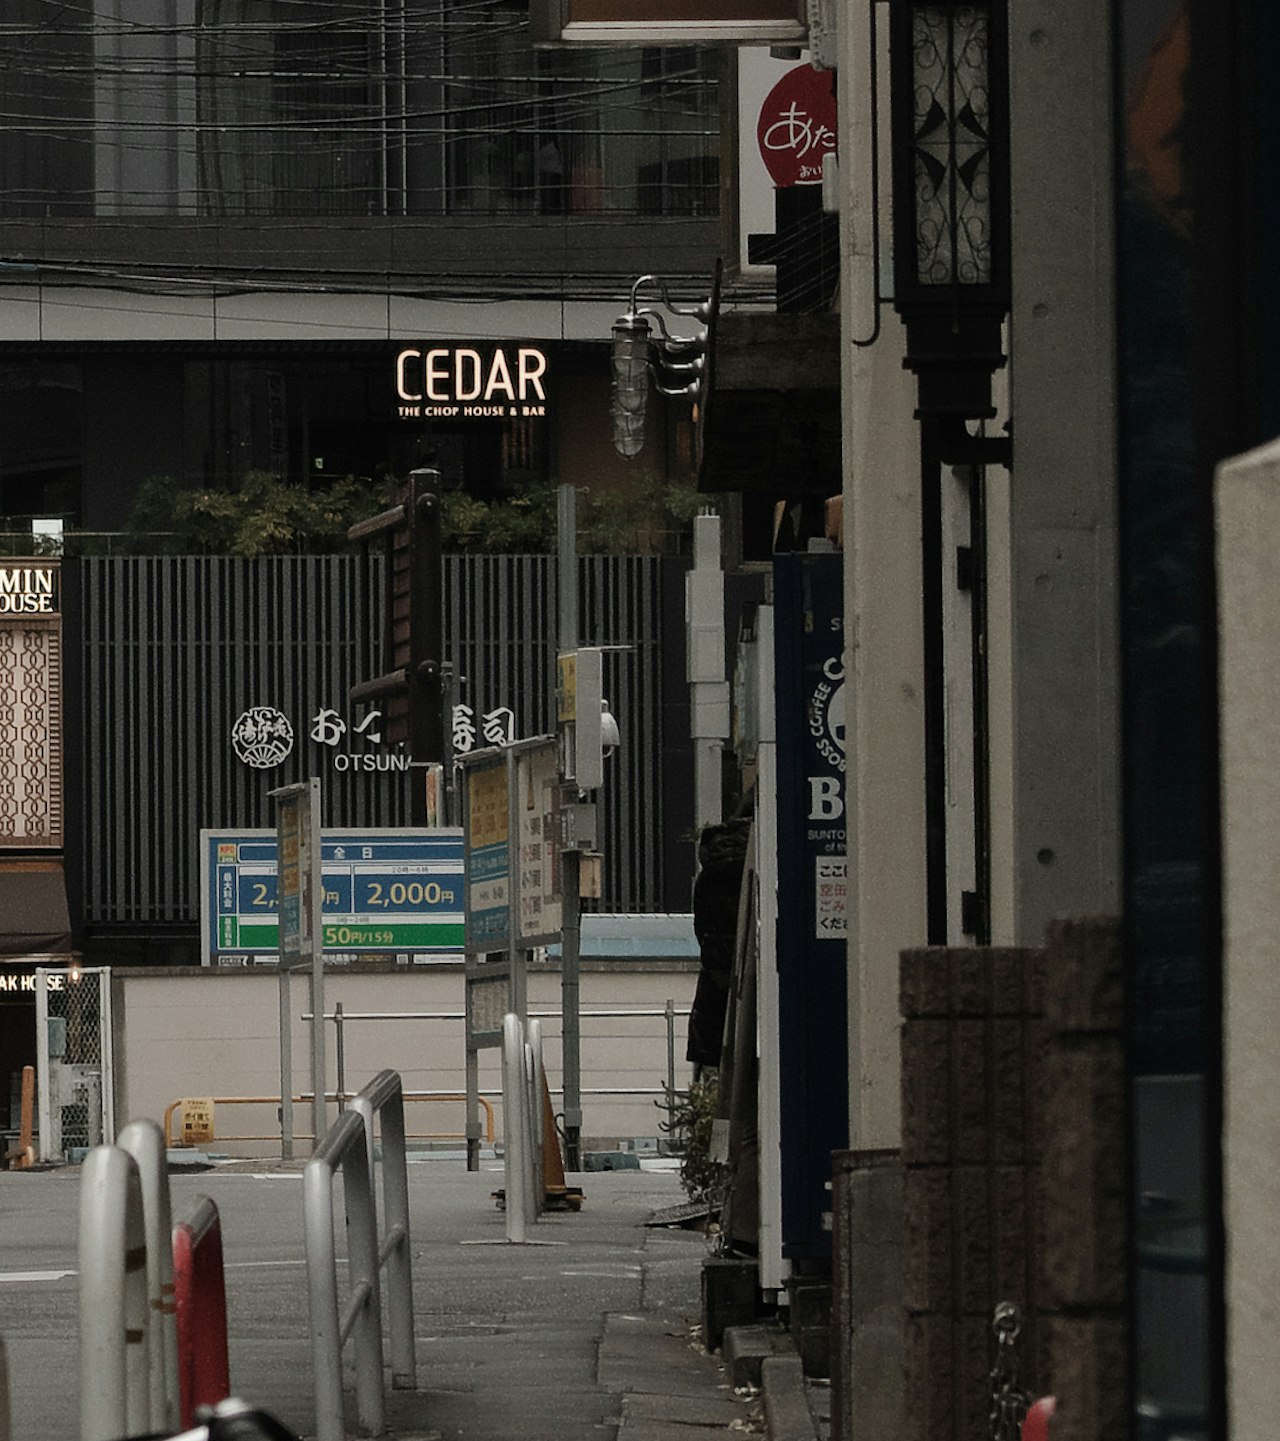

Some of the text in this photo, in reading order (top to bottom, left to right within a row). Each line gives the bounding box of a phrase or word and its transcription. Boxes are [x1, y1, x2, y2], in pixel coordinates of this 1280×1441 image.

[396, 348, 547, 401] CEDAR
[398, 406, 546, 417] THE CHOP HOUSE & BAR
[366, 881, 455, 908] 2,000円
